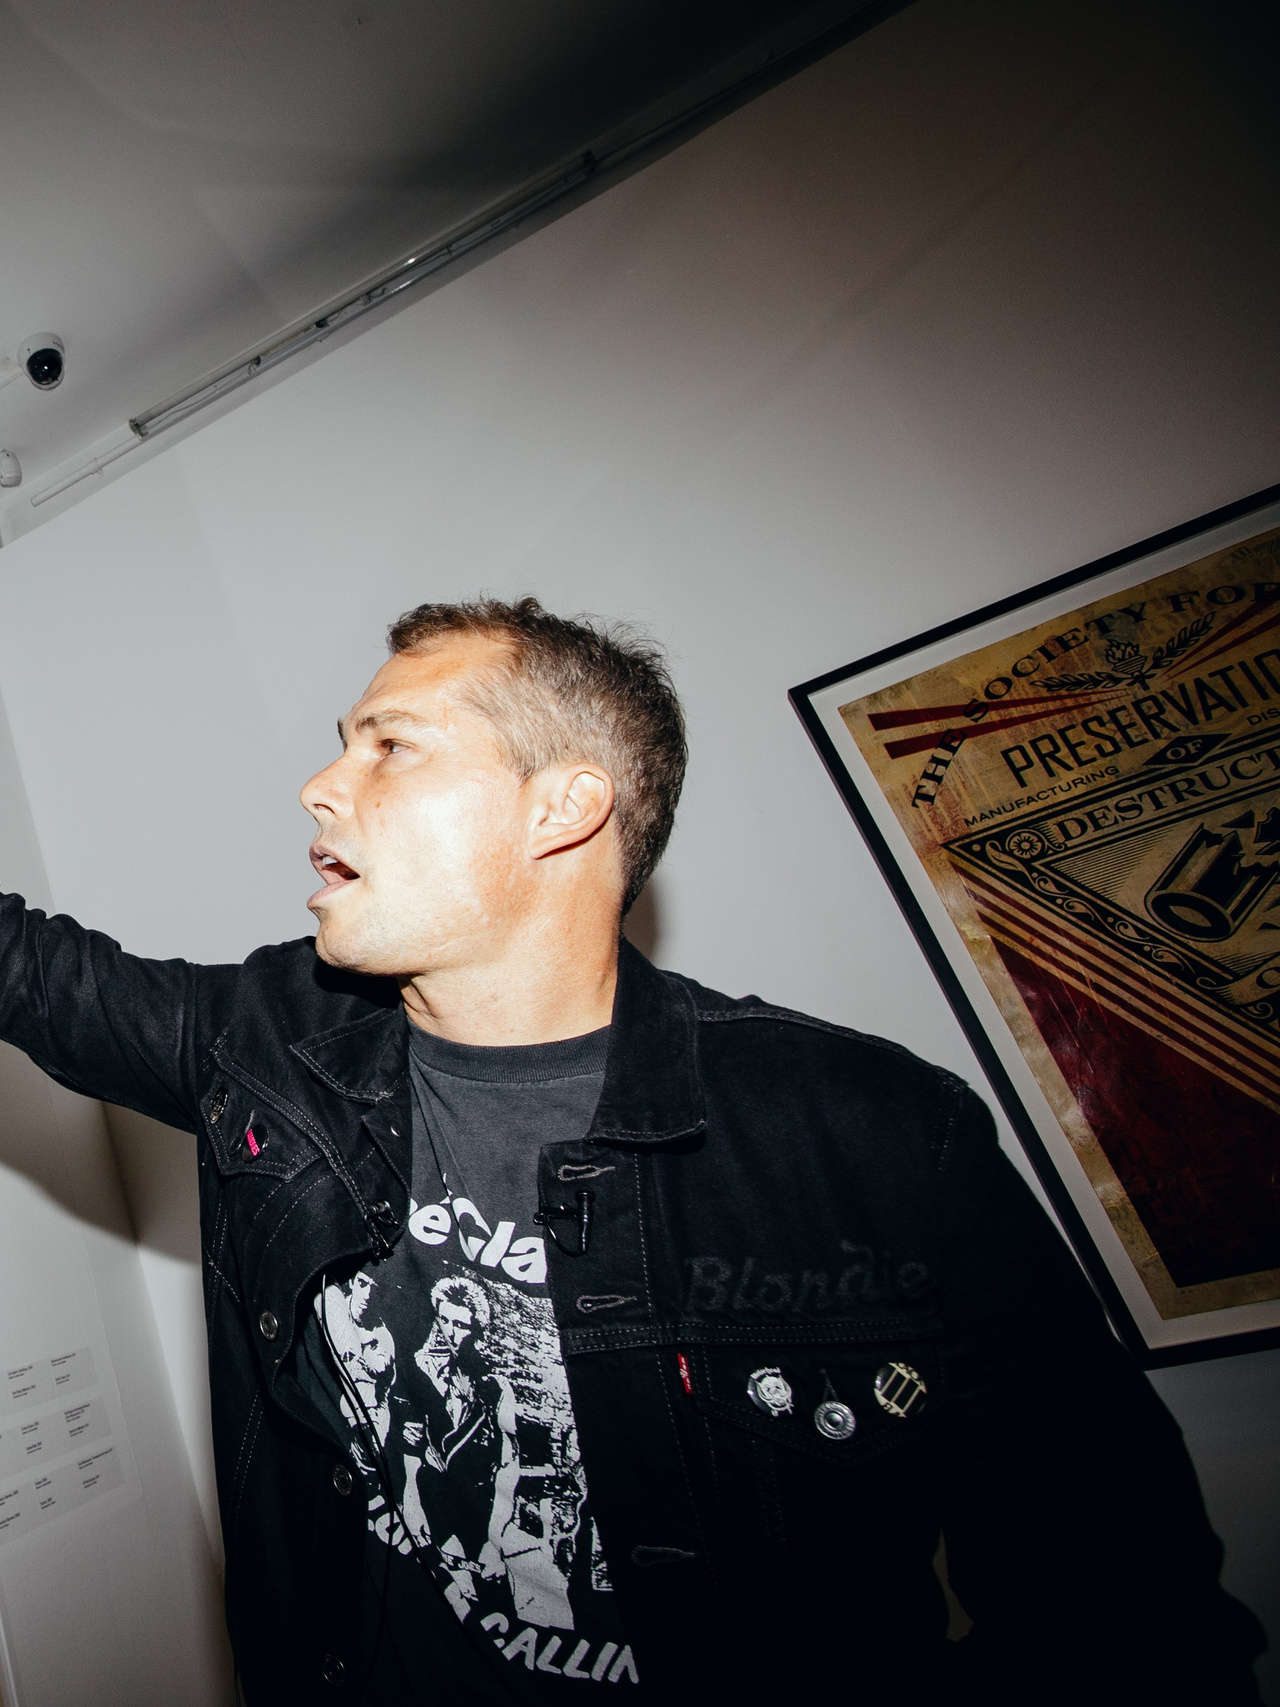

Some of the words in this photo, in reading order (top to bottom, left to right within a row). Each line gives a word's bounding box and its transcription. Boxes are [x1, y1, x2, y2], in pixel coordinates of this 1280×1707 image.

[911, 728, 967, 809] THE
[963, 602, 1147, 723] SOCIETY
[1165, 739, 1204, 760] OF
[963, 764, 1120, 828] MANUFACTURING
[683, 1239, 930, 1313] Blondie
